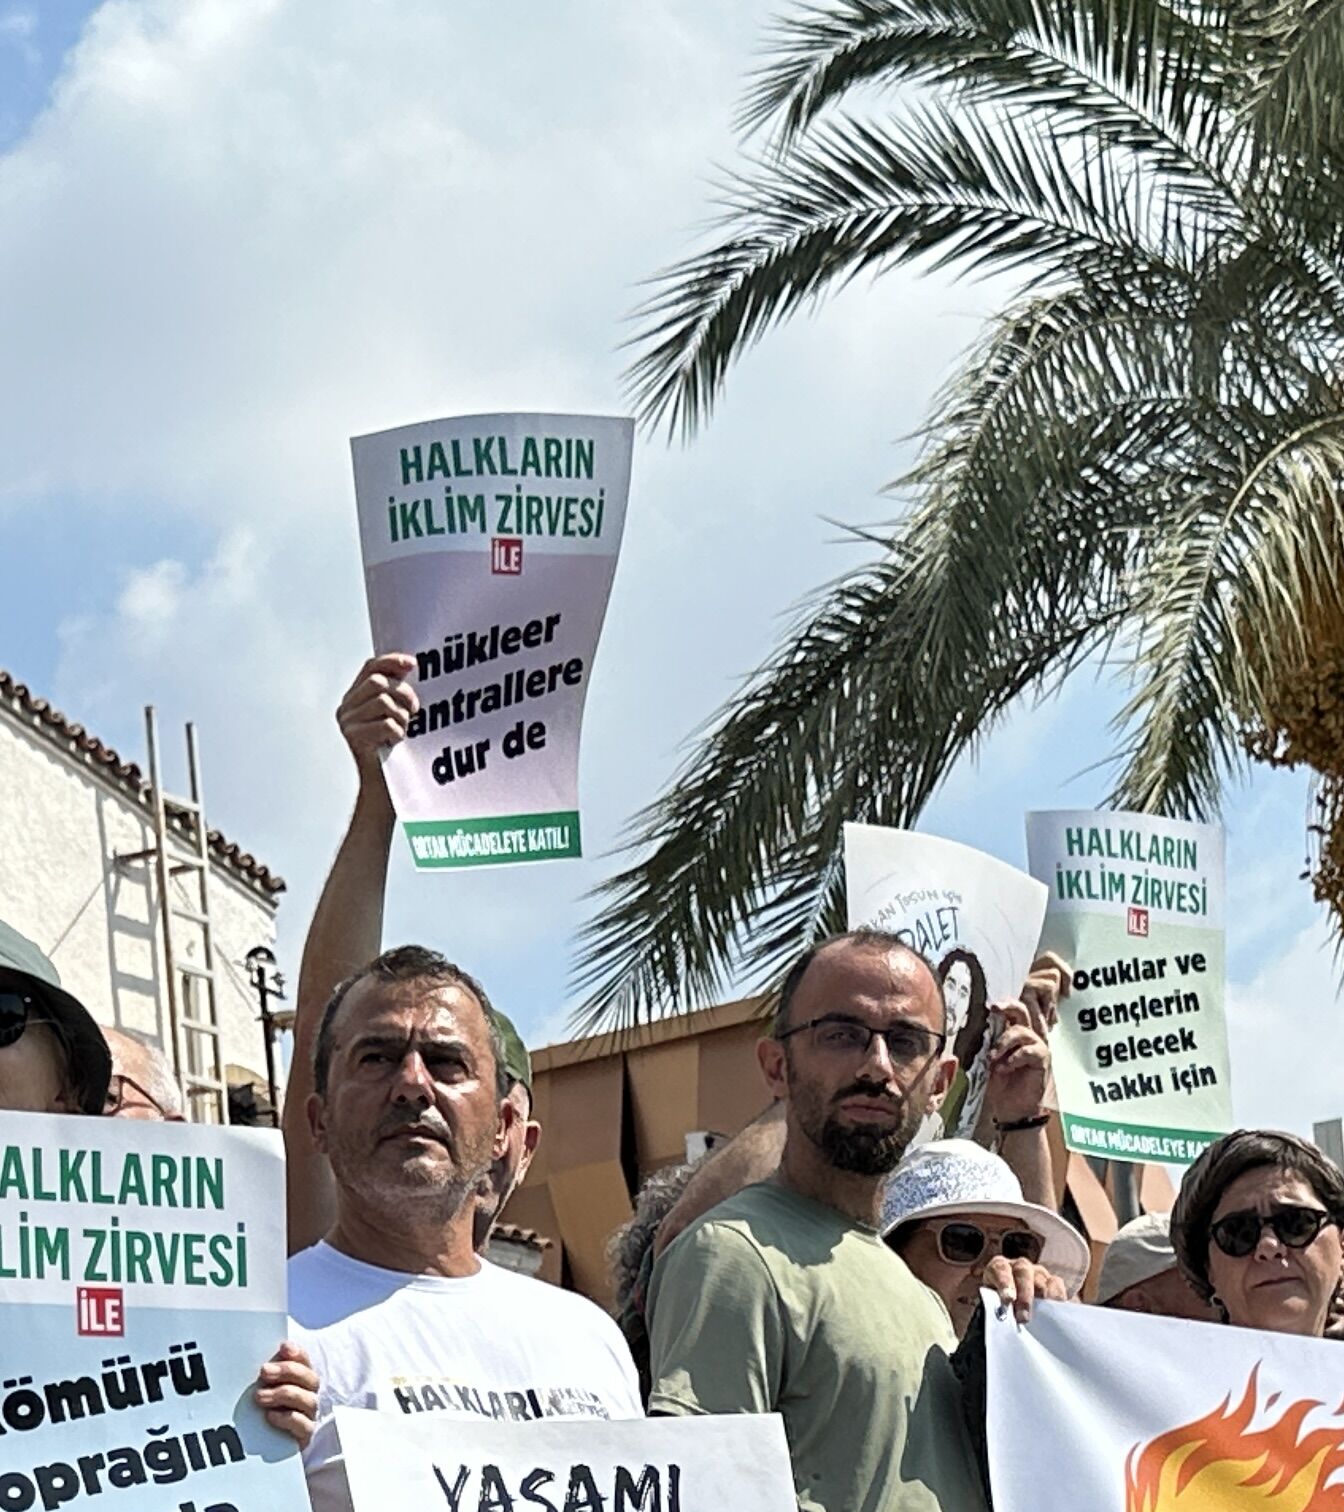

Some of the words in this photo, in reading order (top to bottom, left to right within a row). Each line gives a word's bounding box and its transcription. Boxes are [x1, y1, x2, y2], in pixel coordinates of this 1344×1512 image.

[399, 435, 595, 485] HALKLARIN
[388, 485, 487, 542] İKLİM
[495, 484, 605, 538] ZİRVESİ
[493, 539, 522, 573] İLE
[415, 613, 561, 681] nükleer
[406, 657, 584, 738] antrallere
[431, 739, 490, 786] dur
[502, 720, 547, 759] de
[411, 835, 449, 859] ORTAK
[448, 828, 527, 859] MÜCADELEYE
[527, 825, 570, 852] KATIL!
[1065, 827, 1198, 871] HALKLARIN
[1056, 862, 1126, 903] İKLİM
[1131, 868, 1207, 916] ZİRVESİ
[896, 906, 959, 957] DALET
[1128, 907, 1148, 935] İLE
[1072, 957, 1167, 991] ocuklar
[1174, 952, 1207, 975] ve
[1077, 989, 1201, 1032] gençlerin
[1095, 1026, 1198, 1069] gelecek
[1088, 1072, 1164, 1104] hakkı
[1169, 1063, 1218, 1096] için
[1070, 1124, 1108, 1149] ORTAK
[1107, 1128, 1185, 1158] MÜCADELEYE
[82, 1216, 248, 1288] ZİRVESİ
[79, 1289, 123, 1334] İLE
